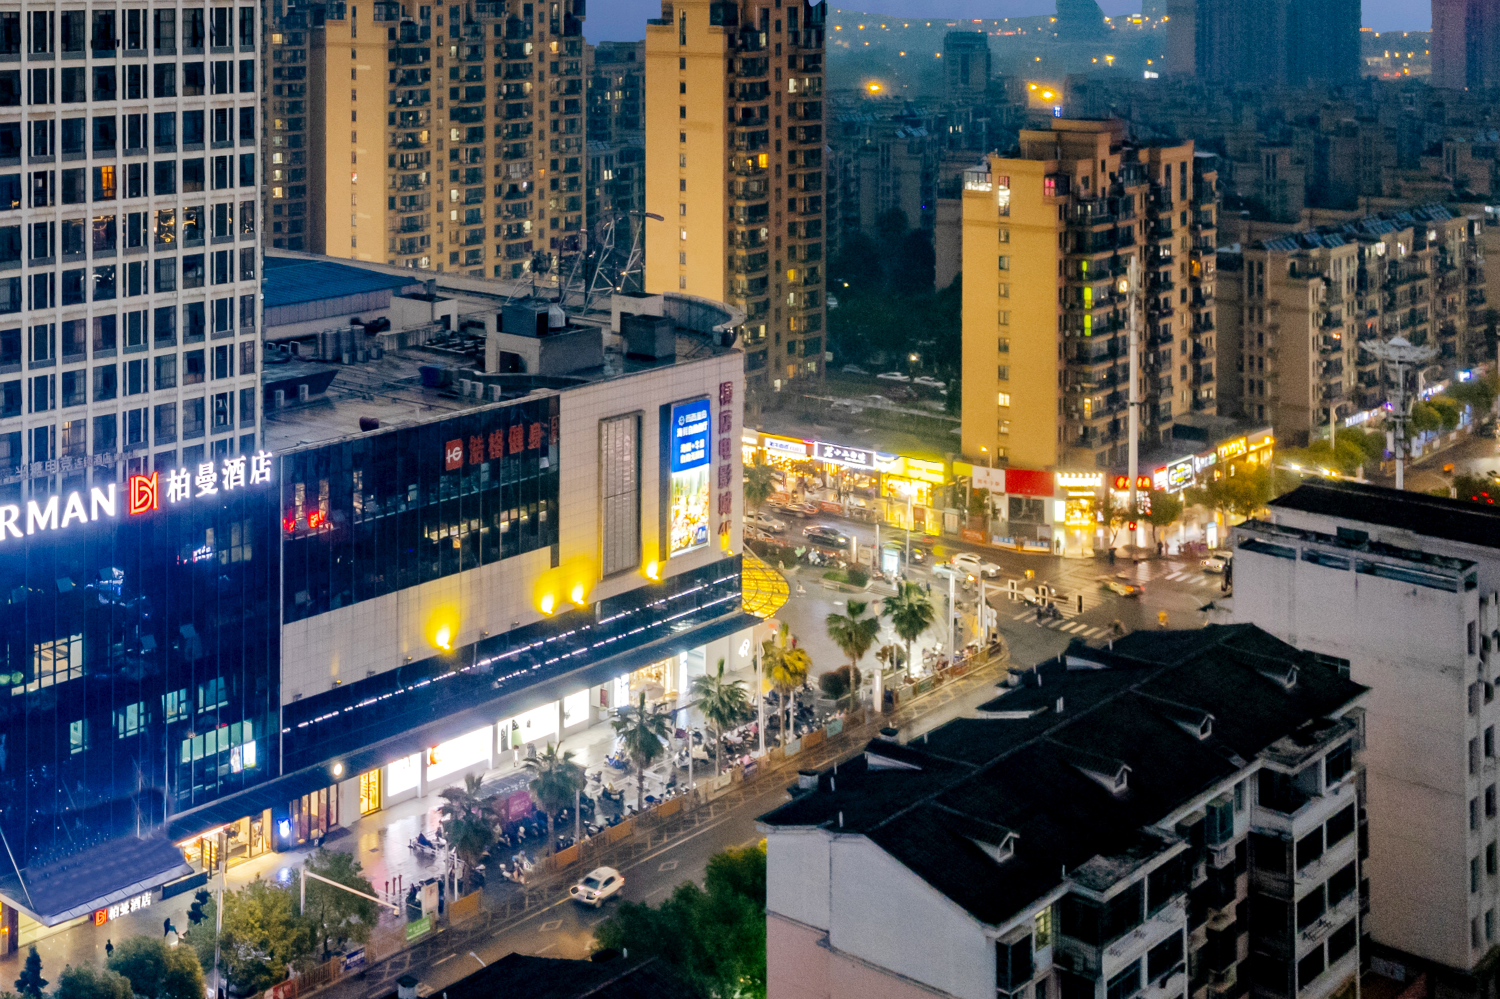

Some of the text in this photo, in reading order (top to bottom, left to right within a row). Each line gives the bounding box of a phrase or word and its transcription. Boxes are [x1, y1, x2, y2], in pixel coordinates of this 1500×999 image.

[718, 381, 733, 516] 横店电影城
[165, 451, 273, 503] 柏曼酒店
[109, 891, 152, 920] 柏曼酒店
